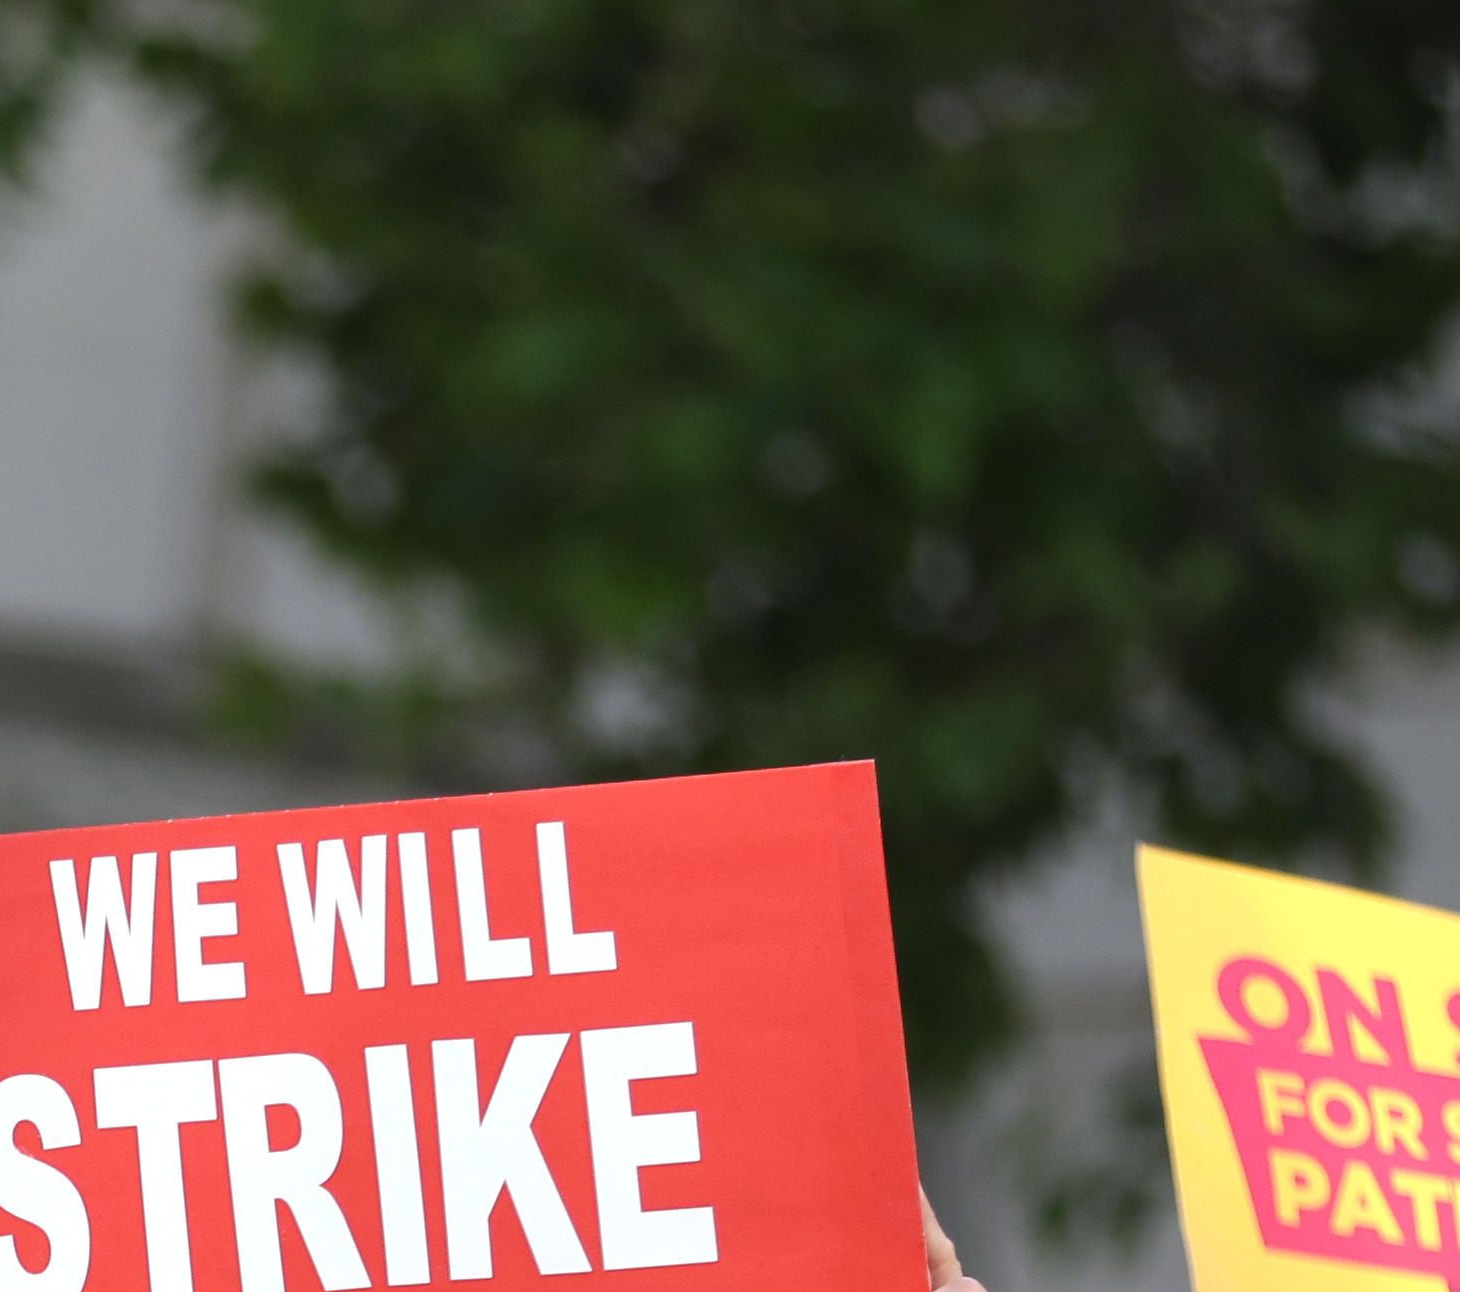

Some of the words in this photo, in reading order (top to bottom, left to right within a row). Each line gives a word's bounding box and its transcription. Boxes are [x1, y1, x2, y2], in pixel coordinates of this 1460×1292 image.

[49, 845, 247, 1011] WE
[278, 821, 618, 997] WILL
[1215, 956, 1413, 1071] ON
[1254, 1069, 1428, 1160] FOR
